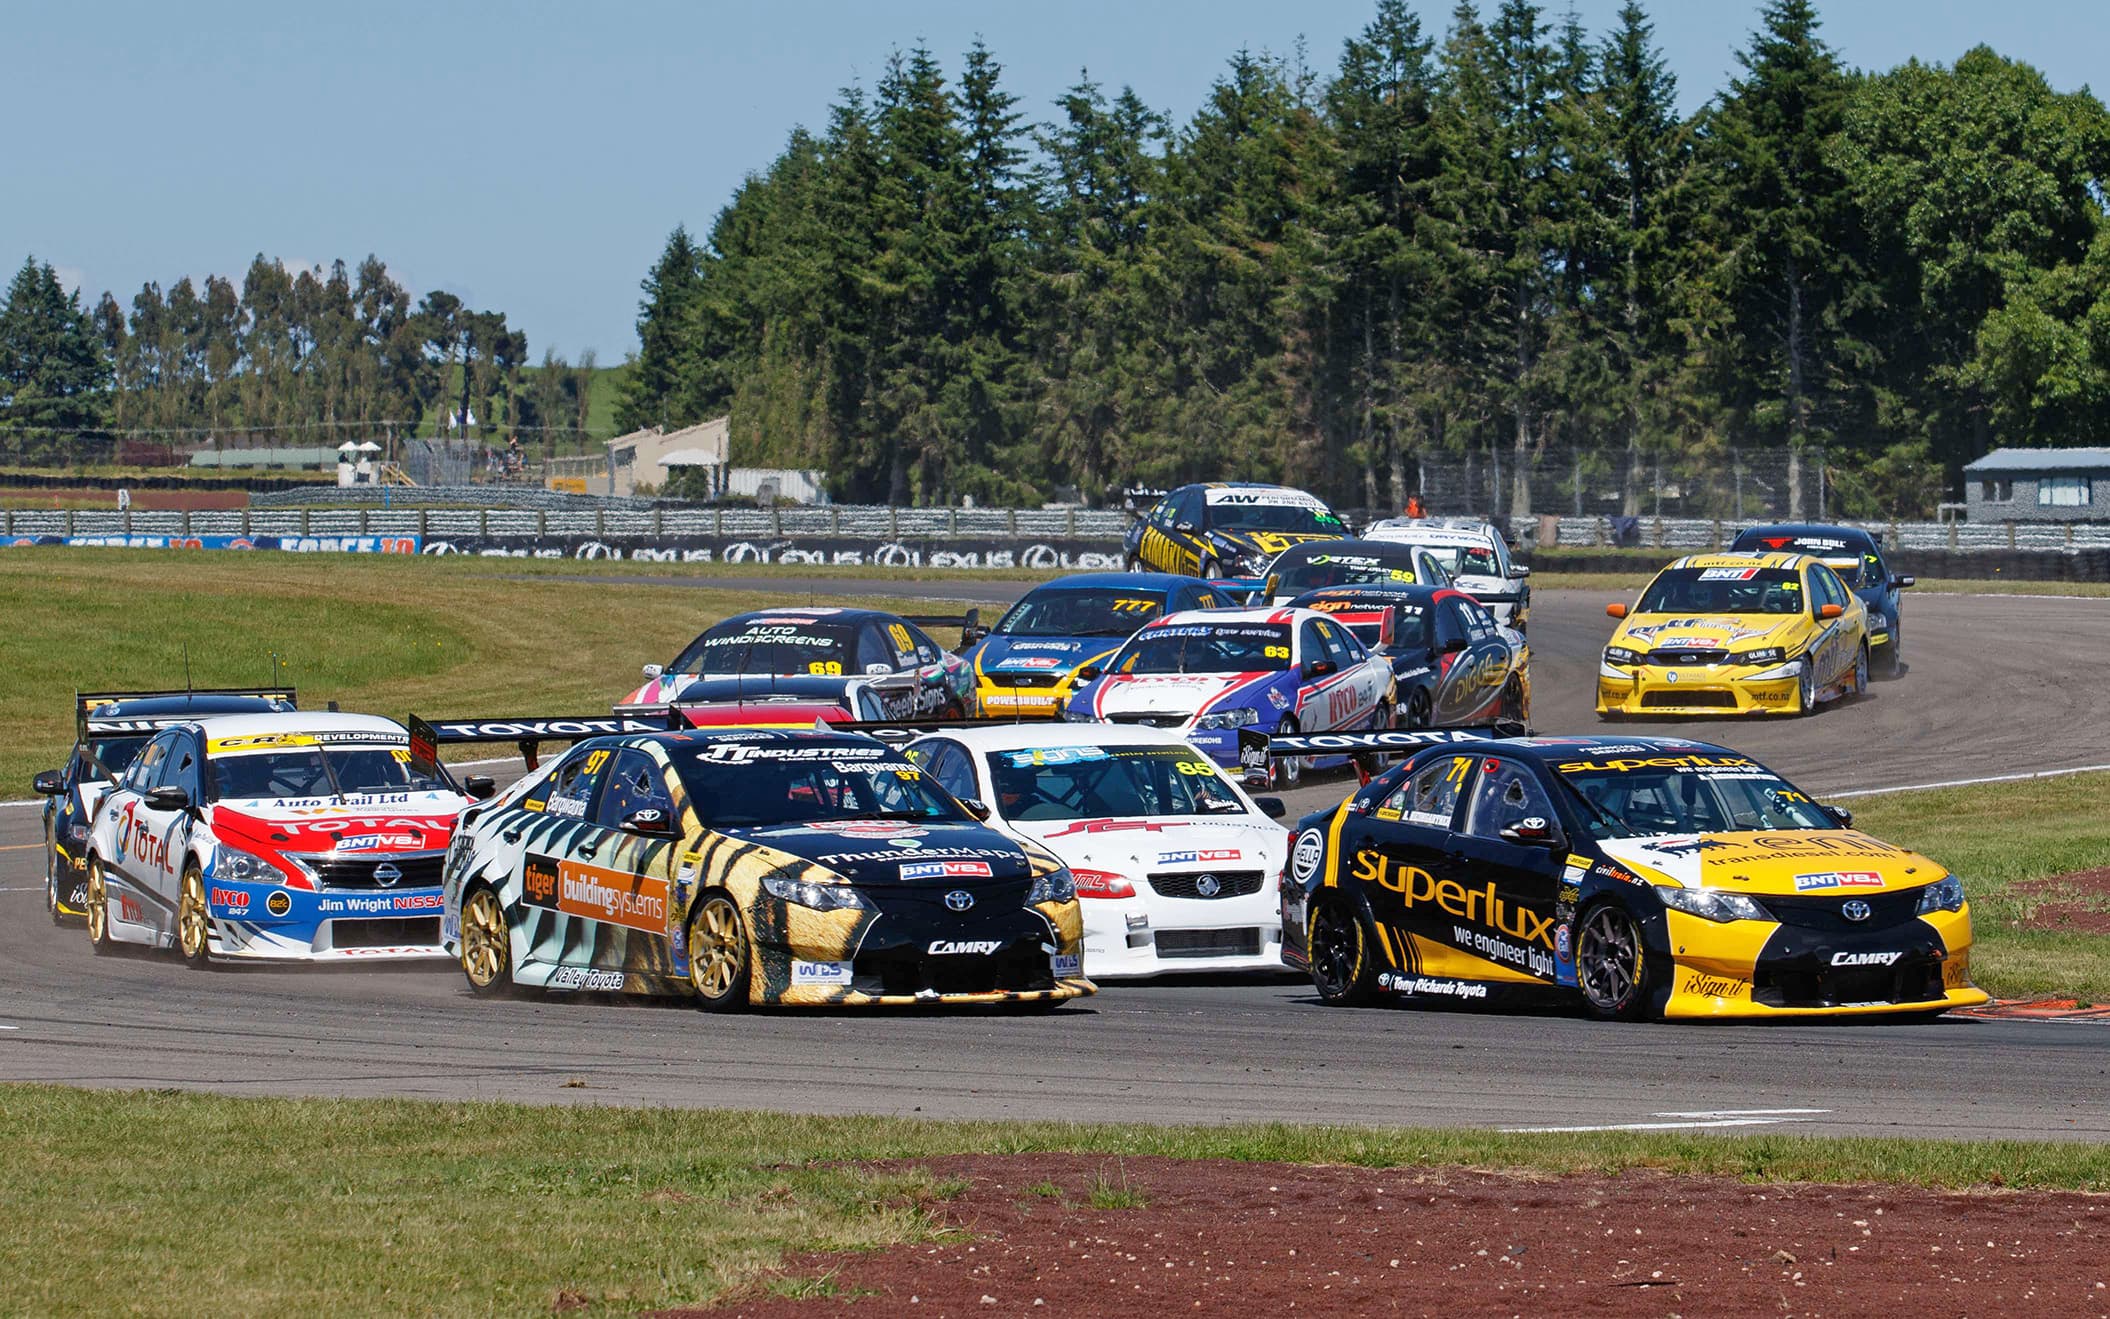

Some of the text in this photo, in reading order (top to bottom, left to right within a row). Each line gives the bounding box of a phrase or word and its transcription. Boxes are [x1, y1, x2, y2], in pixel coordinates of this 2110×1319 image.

[1216, 495, 1260, 503] AW
[1794, 538, 1822, 546] JOHN
[1823, 539, 1846, 548] BULL
[763, 550, 863, 565] LEXUS
[912, 550, 1016, 569] LEXUS
[1390, 569, 1415, 583] 59
[1113, 599, 1157, 612] 777
[1404, 605, 1424, 615] 11
[1460, 603, 1477, 626] 11
[746, 626, 798, 635] AUTO
[888, 623, 914, 653] 69
[1264, 645, 1290, 659] 63
[809, 661, 843, 676] 69
[441, 720, 663, 737] TOYOTA
[1271, 731, 1488, 750] TOYOTA
[584, 750, 610, 775] 97
[831, 761, 921, 775] Bargwanna
[1176, 761, 1216, 777] 85
[1446, 757, 1474, 782] 71
[1558, 755, 1757, 773] superlux
[896, 770, 921, 781] 97
[273, 794, 409, 808] Auto Trail Ltd
[546, 790, 587, 818] Bargwanna
[1777, 791, 1810, 804] 71
[268, 819, 450, 835] TOTAL
[133, 818, 174, 875] TOTAL
[1753, 833, 1899, 852] eni
[817, 847, 1025, 866] ThunderMaps
[1707, 849, 1898, 867] transdiesel.com
[526, 863, 557, 901] tiger
[1595, 864, 1644, 886] civiltrain.nz
[318, 895, 445, 912] Jim Wright NISSA
[1352, 849, 1555, 951] superlux
[336, 948, 432, 956] TOTAL
[928, 940, 1002, 955] CAMRY
[1454, 924, 1555, 977] we engineer light
[1830, 951, 1903, 966] CAMRY
[556, 967, 624, 990] Valley Toyota
[1393, 976, 1487, 998] Tony Richards Toyota
[1683, 974, 1753, 998] iSign it
